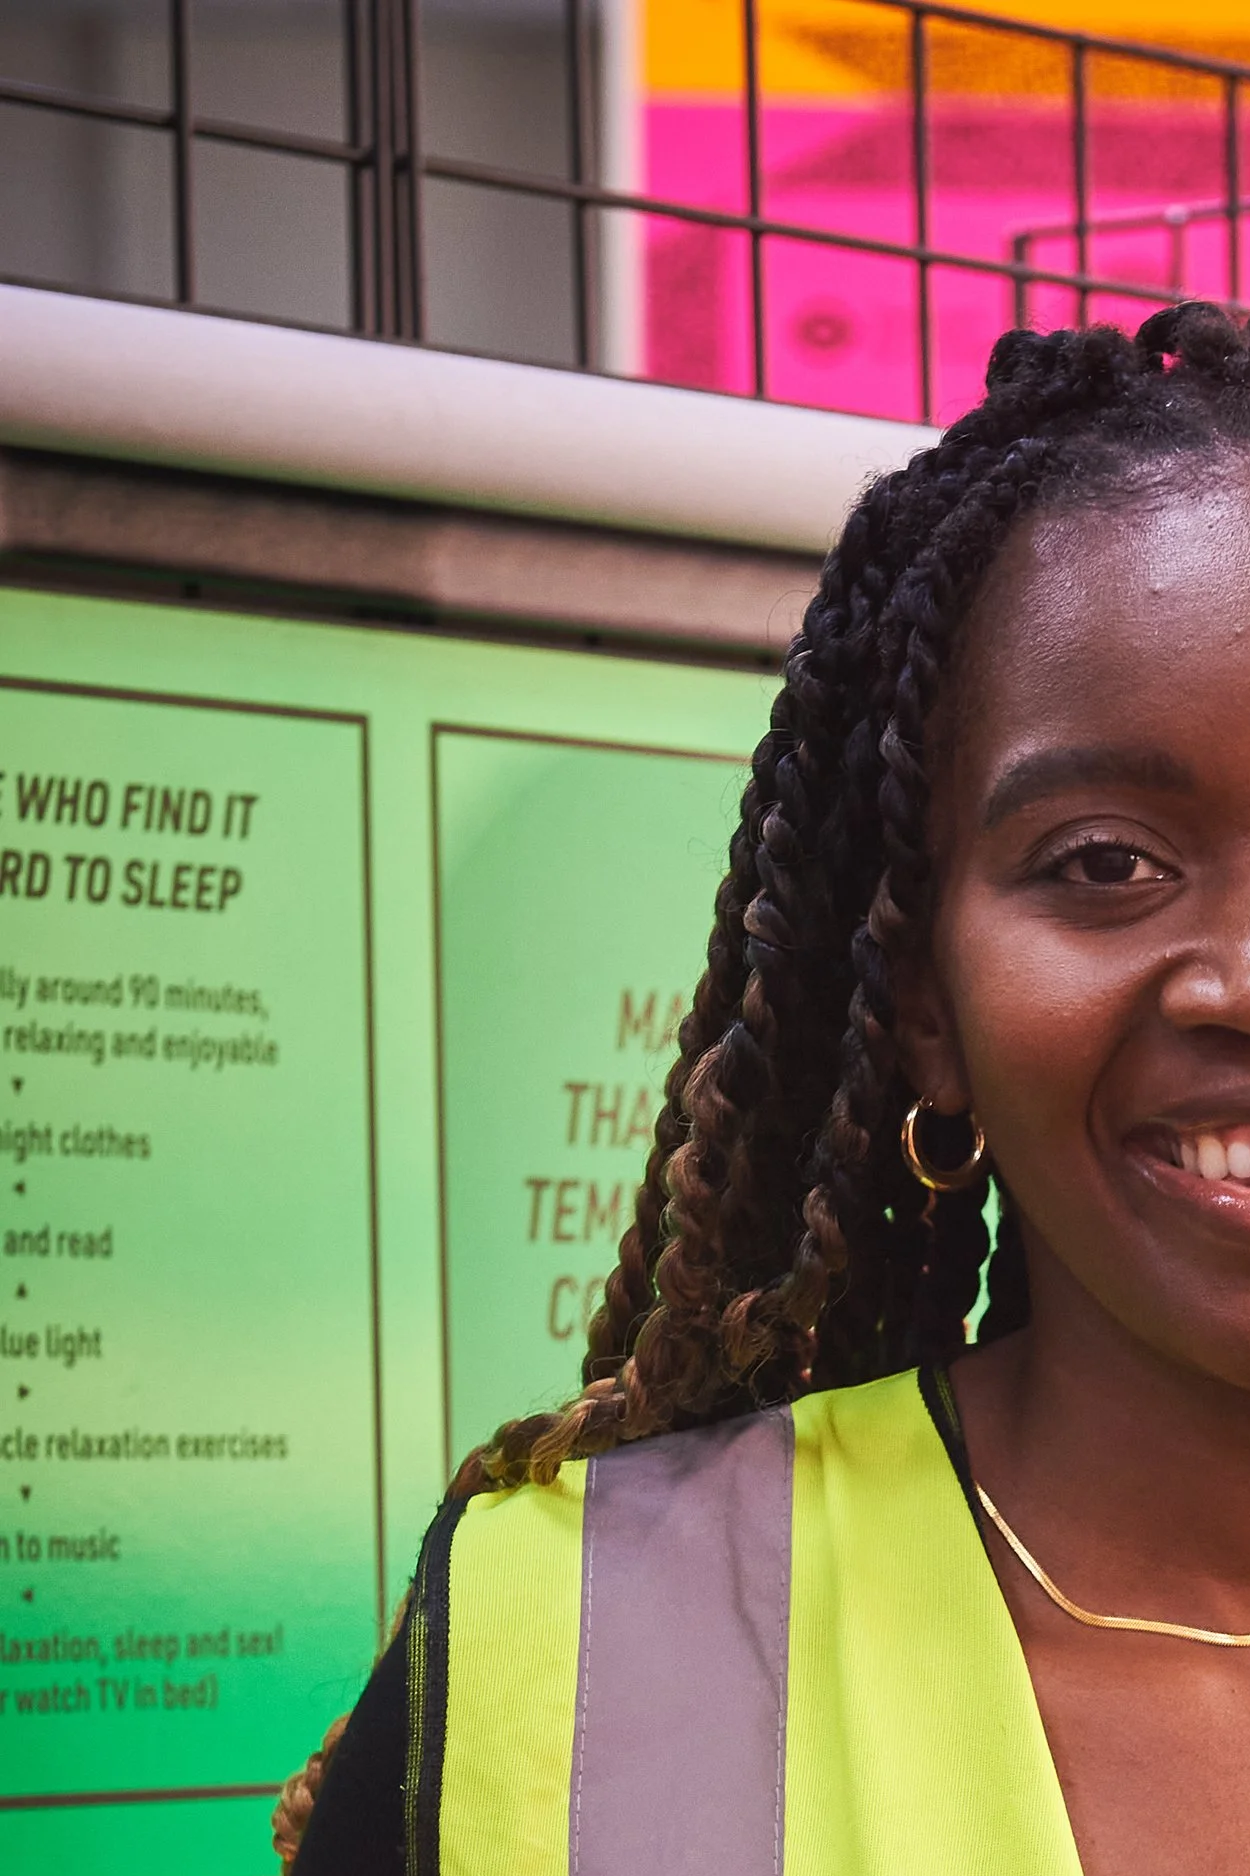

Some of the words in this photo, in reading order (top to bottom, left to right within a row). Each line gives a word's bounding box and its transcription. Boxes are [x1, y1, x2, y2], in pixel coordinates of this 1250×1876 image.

[15, 768, 112, 830] WHO
[120, 783, 214, 839] FIND
[221, 792, 260, 840] IT
[64, 853, 112, 906] TO
[121, 861, 244, 913] SLEEP
[35, 975, 123, 1008] around
[128, 973, 160, 1009] 90
[164, 980, 270, 1022] minutes,
[3, 1020, 105, 1067] relaxing
[111, 1027, 157, 1062] and
[162, 1033, 279, 1071] enjoyable
[0, 1120, 53, 1165] ight
[59, 1121, 151, 1160] clothes
[523, 1175, 641, 1244] TEM
[4, 1221, 50, 1259] and
[56, 1224, 113, 1260] read
[46, 1323, 103, 1370] light
[45, 1427, 170, 1462] relaxation
[176, 1428, 289, 1462] exercises
[17, 1530, 41, 1562] to
[48, 1529, 121, 1562] music
[114, 1627, 181, 1666] sleep
[187, 1625, 231, 1659] and
[14, 1678, 91, 1713] watch
[96, 1676, 130, 1711] TV
[134, 1674, 158, 1709] in
